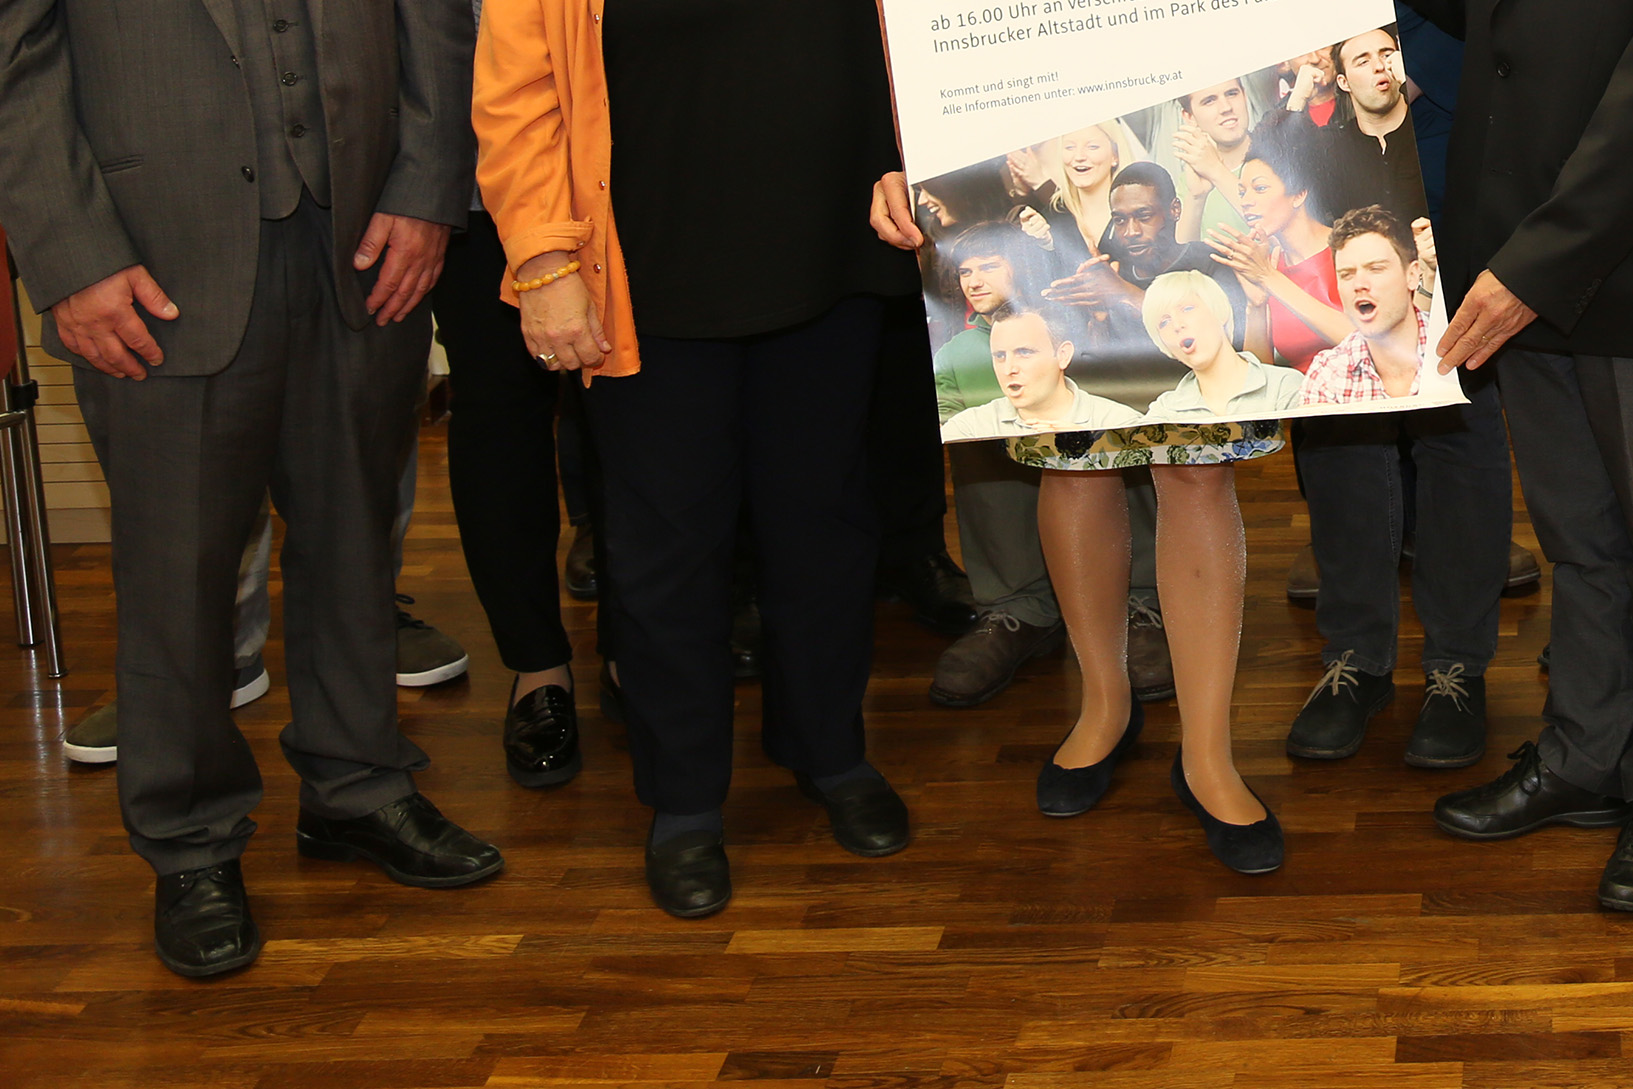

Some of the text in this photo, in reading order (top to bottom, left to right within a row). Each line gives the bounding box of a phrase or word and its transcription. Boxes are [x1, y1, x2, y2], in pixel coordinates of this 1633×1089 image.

[930, 14, 951, 32] ab
[956, 6, 1003, 28] 16.00
[1008, 1, 1038, 20] Uhr
[1043, 0, 1063, 14] an
[933, 26, 1032, 54] Innsbrucker
[1037, 13, 1103, 37] Altstadt
[1107, 7, 1139, 27] und
[1143, 6, 1165, 21] im
[939, 71, 1059, 99] Kommt und singt mit!
[942, 70, 1183, 116] Alle Informationen unter: www.innsbruck.gv.at
